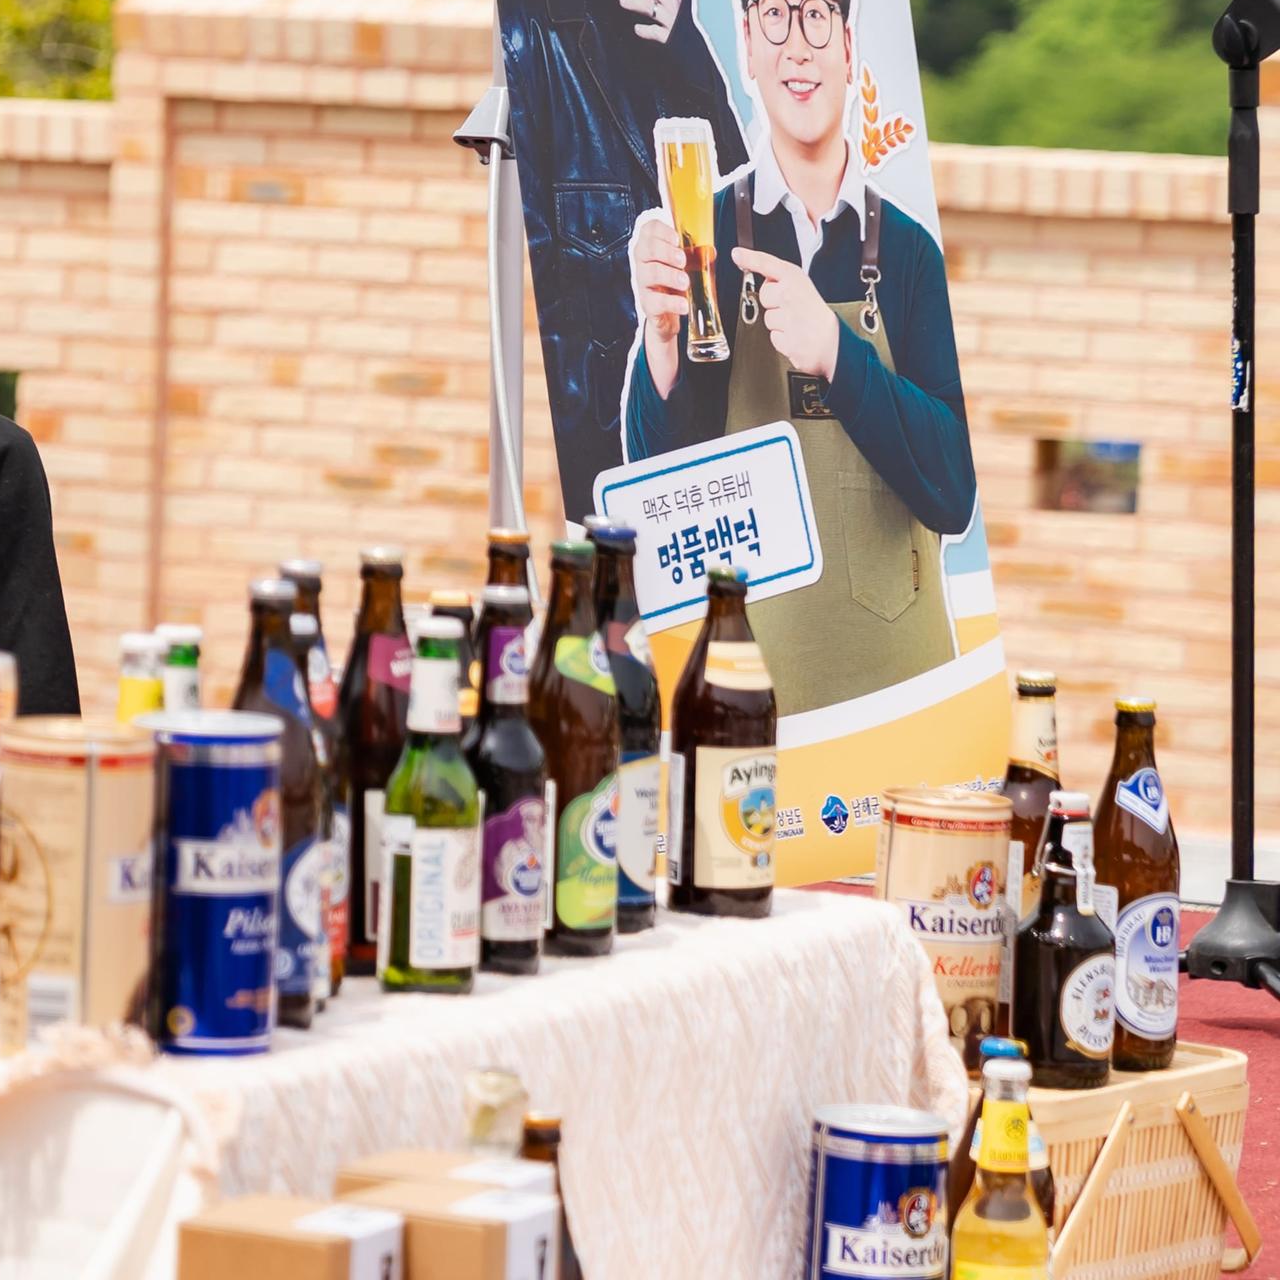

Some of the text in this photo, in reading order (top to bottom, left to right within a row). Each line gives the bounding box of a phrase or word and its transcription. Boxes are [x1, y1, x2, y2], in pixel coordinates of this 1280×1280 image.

[642, 470, 753, 524] 맥주 덕후 유튜버
[657, 507, 761, 585] 명품맥덕
[729, 759, 776, 784] Aying
[776, 808, 803, 827] 상남도
[851, 796, 881, 819] 남해군
[776, 827, 805, 839] EONGNAM
[909, 904, 1003, 936] Kaiserd
[840, 1233, 944, 1267] Kaiserd
